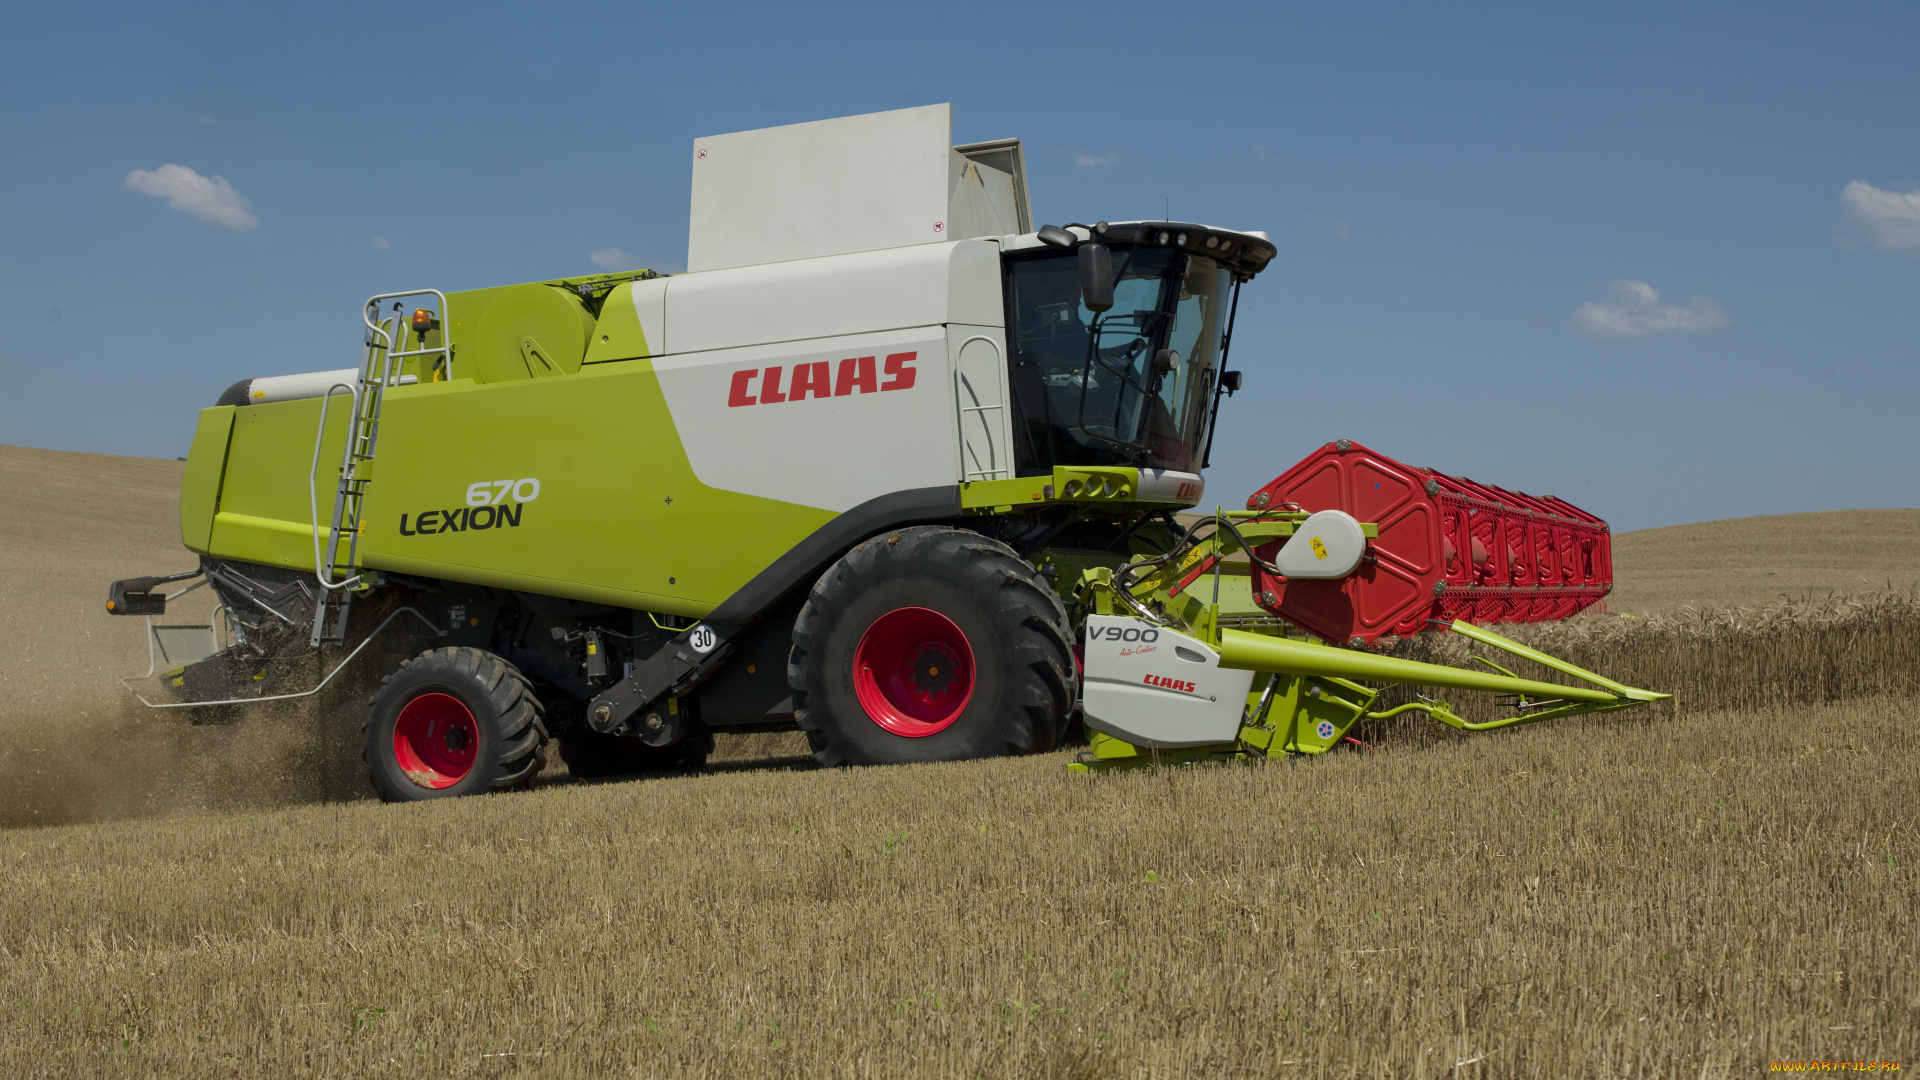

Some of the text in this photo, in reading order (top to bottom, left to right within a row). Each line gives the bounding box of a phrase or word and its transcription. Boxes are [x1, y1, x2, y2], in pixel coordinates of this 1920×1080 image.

[728, 351, 918, 408] CLAAS
[466, 478, 541, 507] 670
[400, 503, 523, 536] LEXION
[694, 629, 712, 648] 30
[1089, 626, 1159, 643] V900
[1143, 674, 1196, 692] CLAAS
